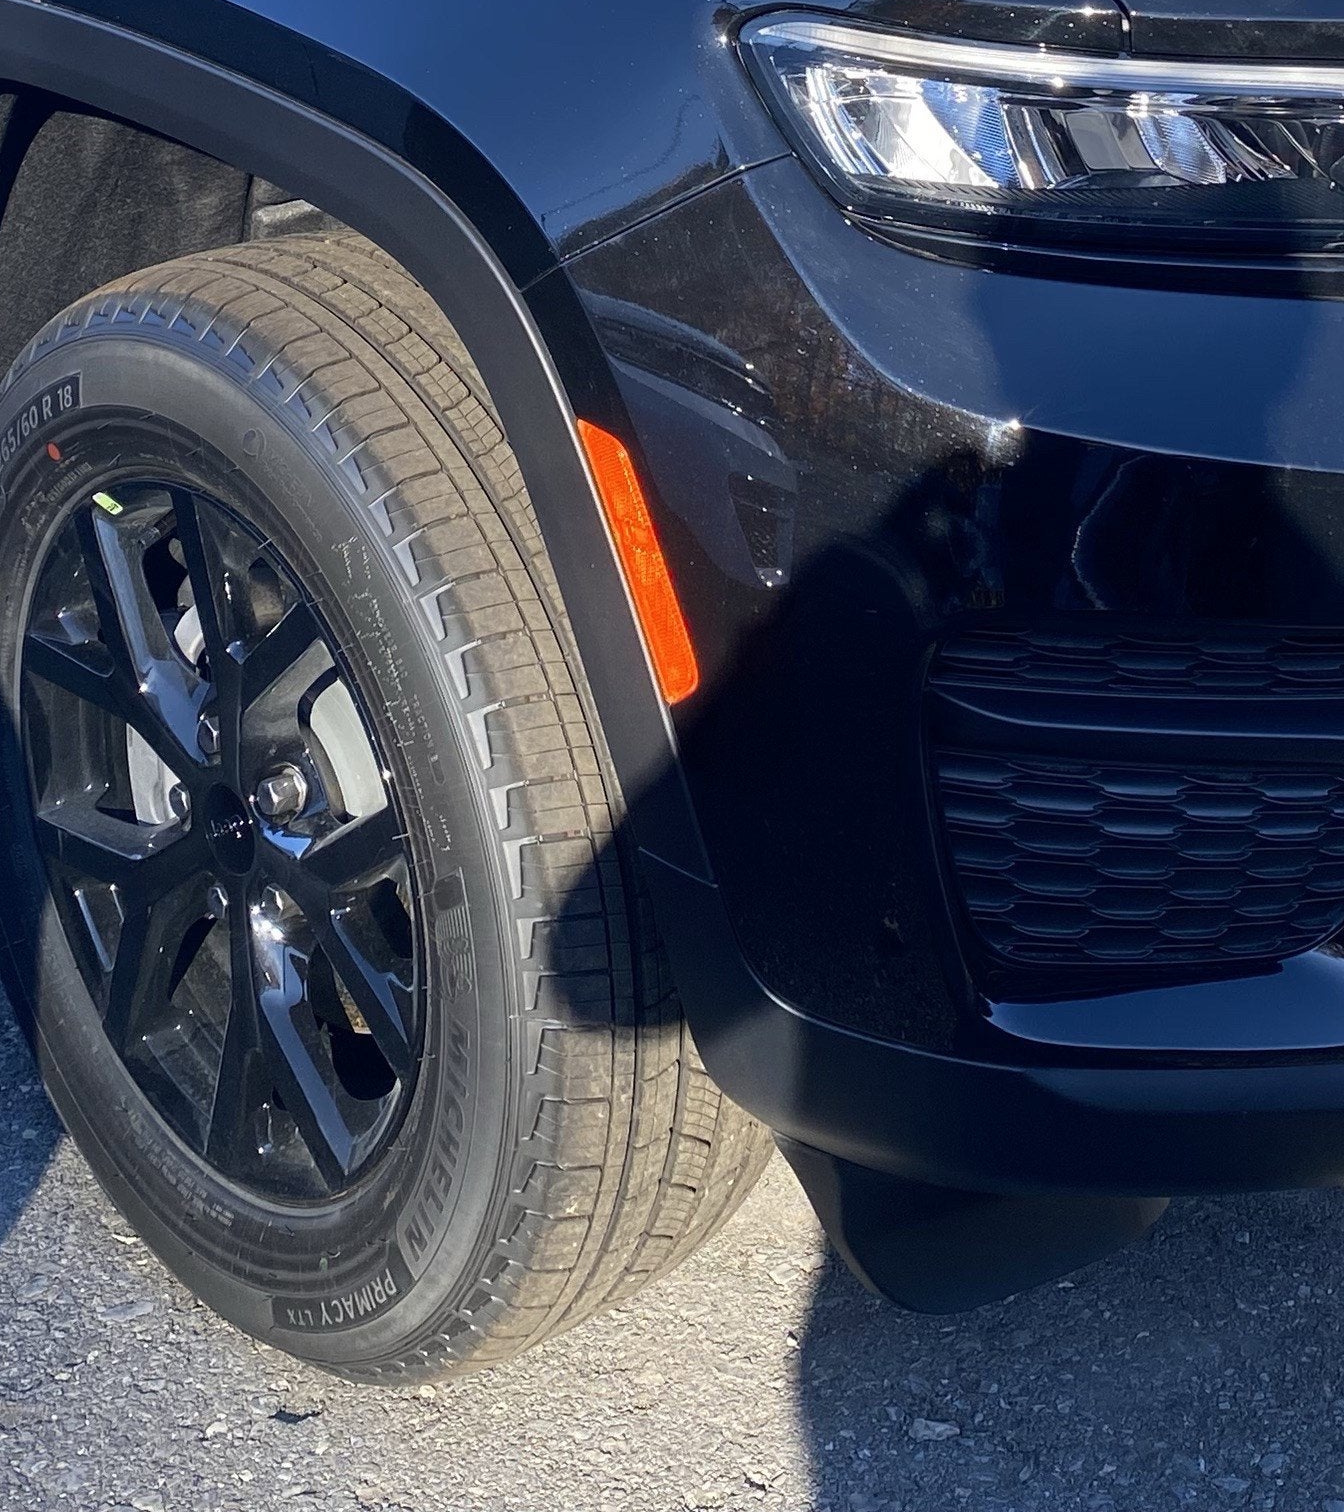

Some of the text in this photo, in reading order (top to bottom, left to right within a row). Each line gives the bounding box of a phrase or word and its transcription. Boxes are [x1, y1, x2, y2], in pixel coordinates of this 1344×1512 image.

[408, 150, 495, 175] 18237
[42, 395, 53, 421] R
[57, 385, 73, 411] 18
[404, 1016, 471, 1263] MICHELIN
[286, 1268, 398, 1327] PRIMACY LTX
